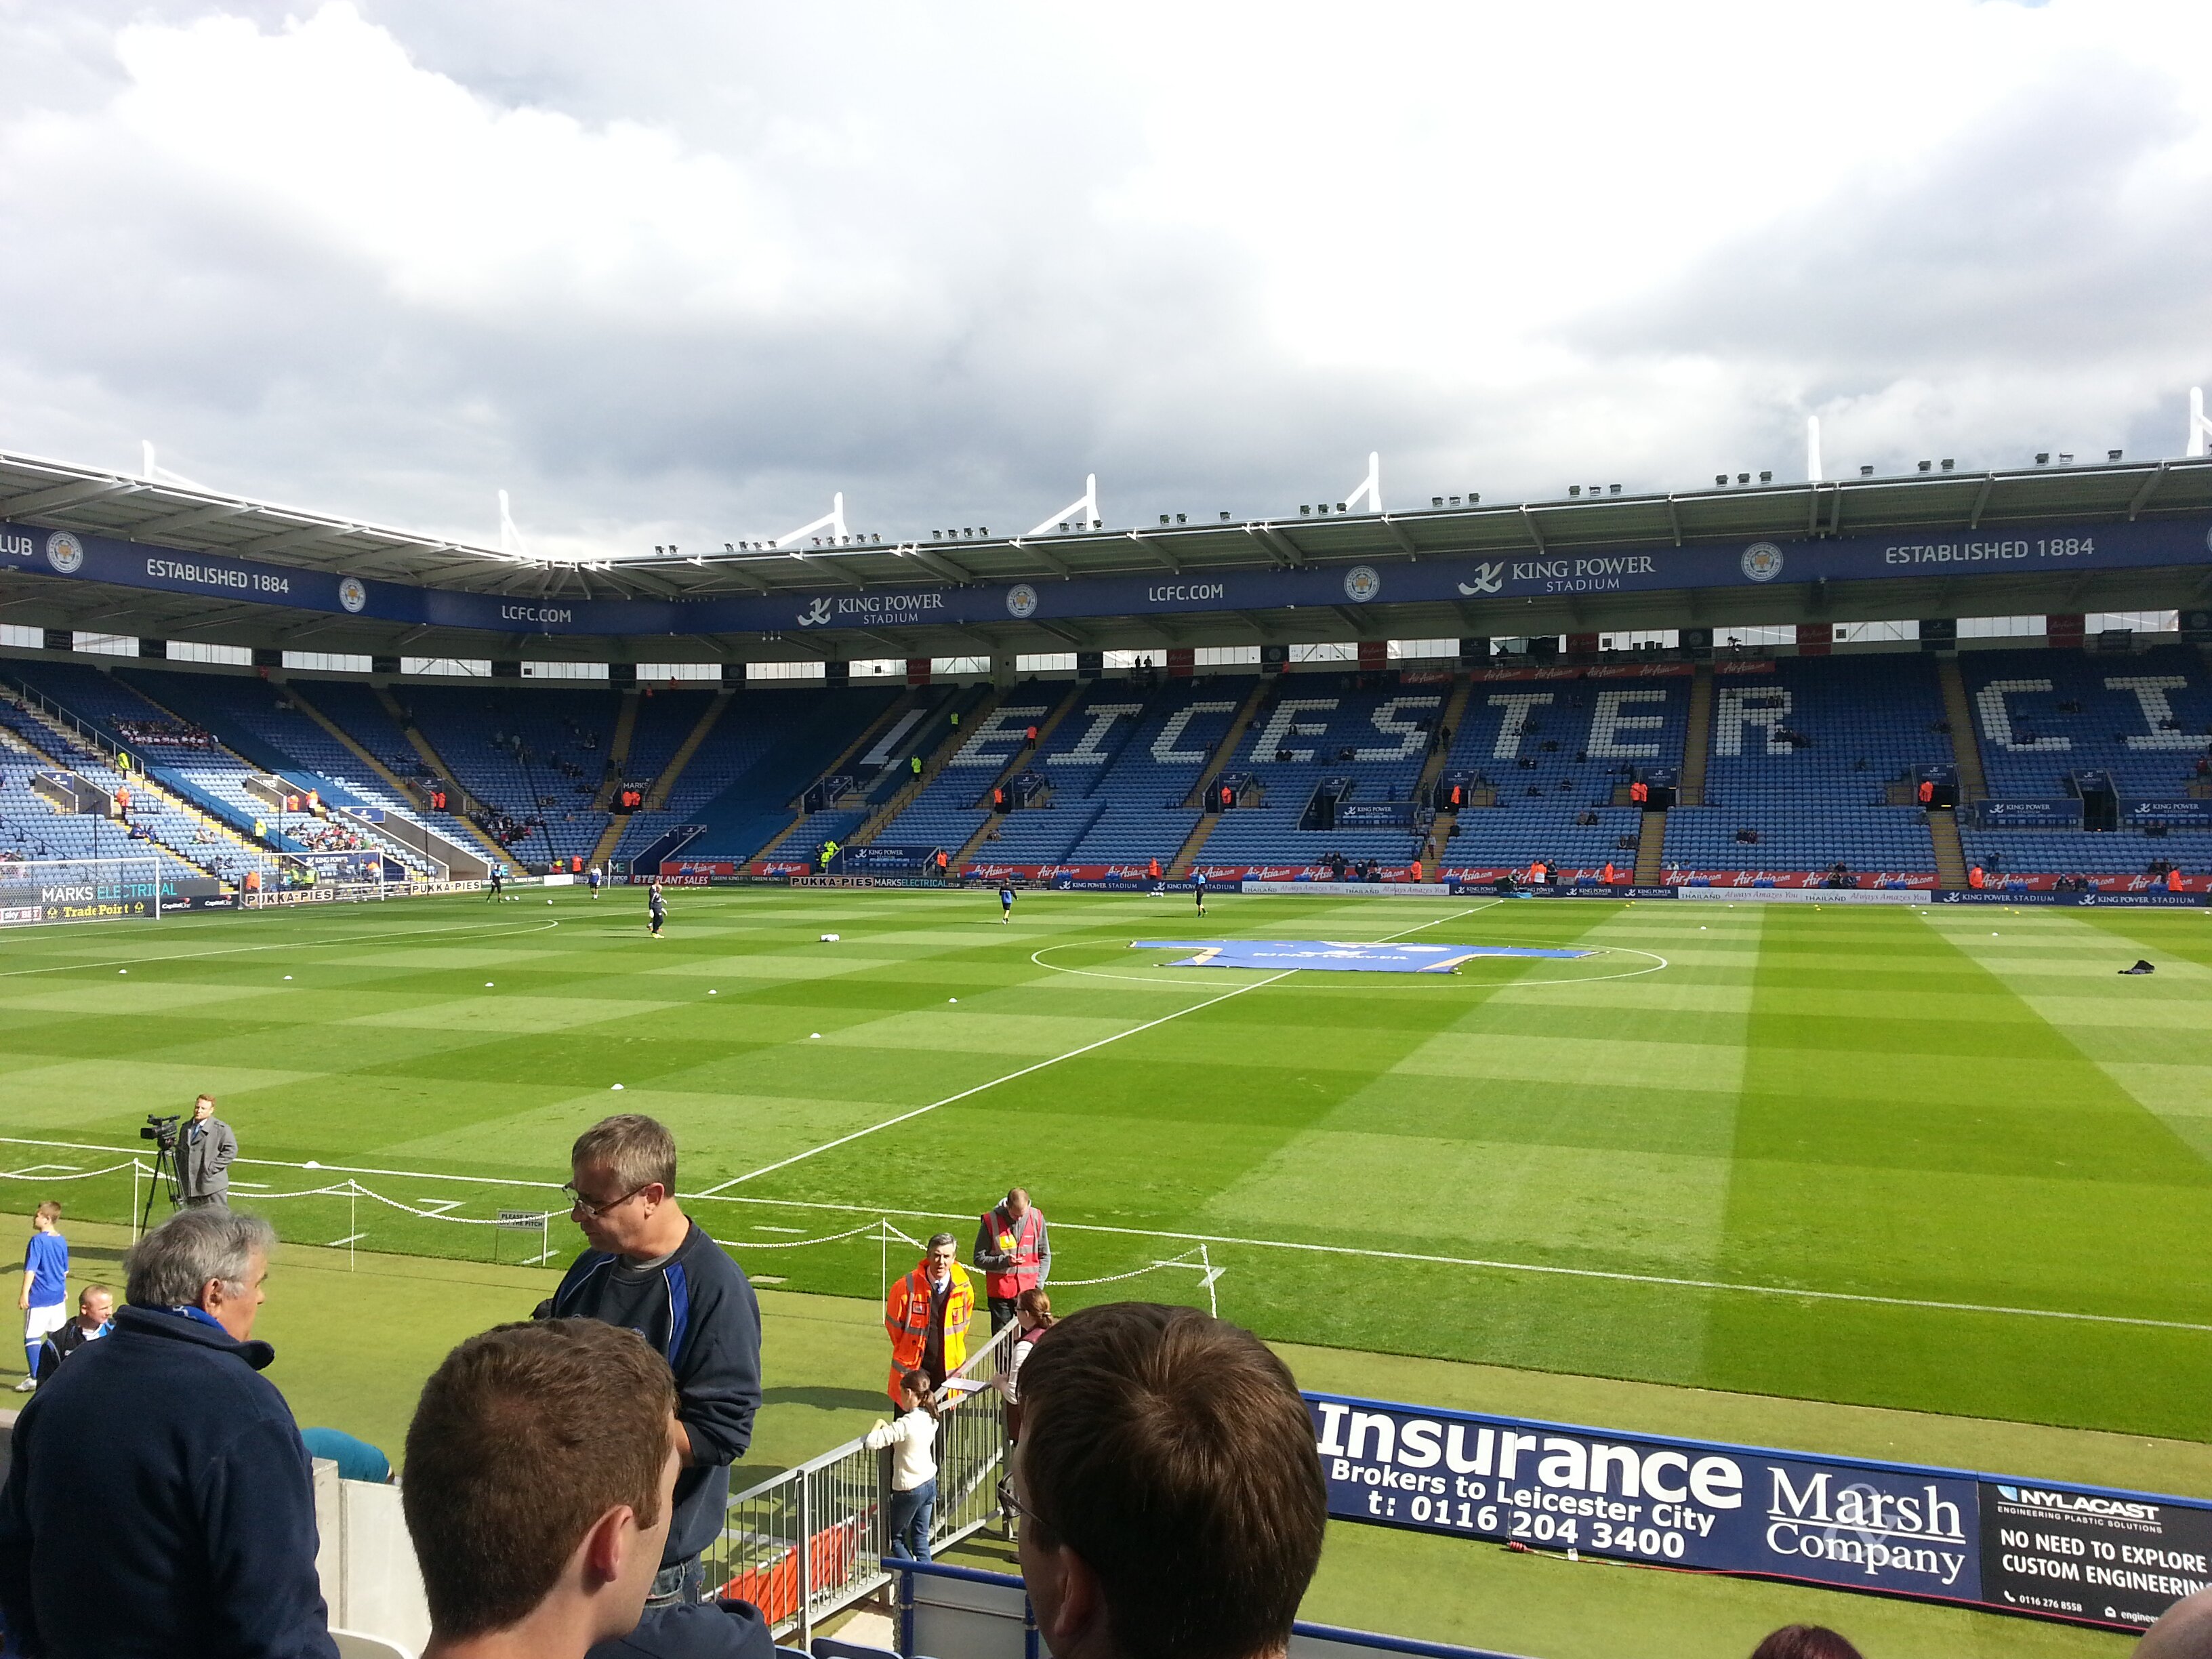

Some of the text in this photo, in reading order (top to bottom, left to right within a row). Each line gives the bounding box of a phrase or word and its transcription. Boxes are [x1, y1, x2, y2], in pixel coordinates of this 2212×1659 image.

[1885, 537, 2095, 564] ESTABLISHED 1884
[146, 558, 289, 594] ESTABLISHED 1884
[1512, 556, 1656, 581] KING POWER
[1149, 583, 1224, 602] LCFC.COM
[1547, 577, 1620, 593] STADIUM
[501, 605, 572, 623] LCFC.COM
[838, 593, 945, 614] KING POWER
[863, 613, 918, 625] STADIUM
[42, 885, 94, 903] MARKS
[684, 876, 708, 885] SALES
[1315, 1400, 1744, 1511] Insurance
[1331, 1458, 1716, 1538] Brokers to Leicester City
[1767, 1466, 1965, 1538] Marsh
[2020, 1489, 2160, 1521] NYLACAST
[1368, 1491, 1685, 1559] t: 0116 204 3400
[1997, 1505, 2163, 1534] ENGINEERING PLASTIC SOLUTIONS
[1766, 1522, 1966, 1586] Company
[2001, 1528, 2208, 1574] NO NEED TO EXPLORE
[2002, 1554, 2212, 1597] CUSTOM ENGINEERIN
[2019, 1595, 2083, 1612] 0116 276 8558
